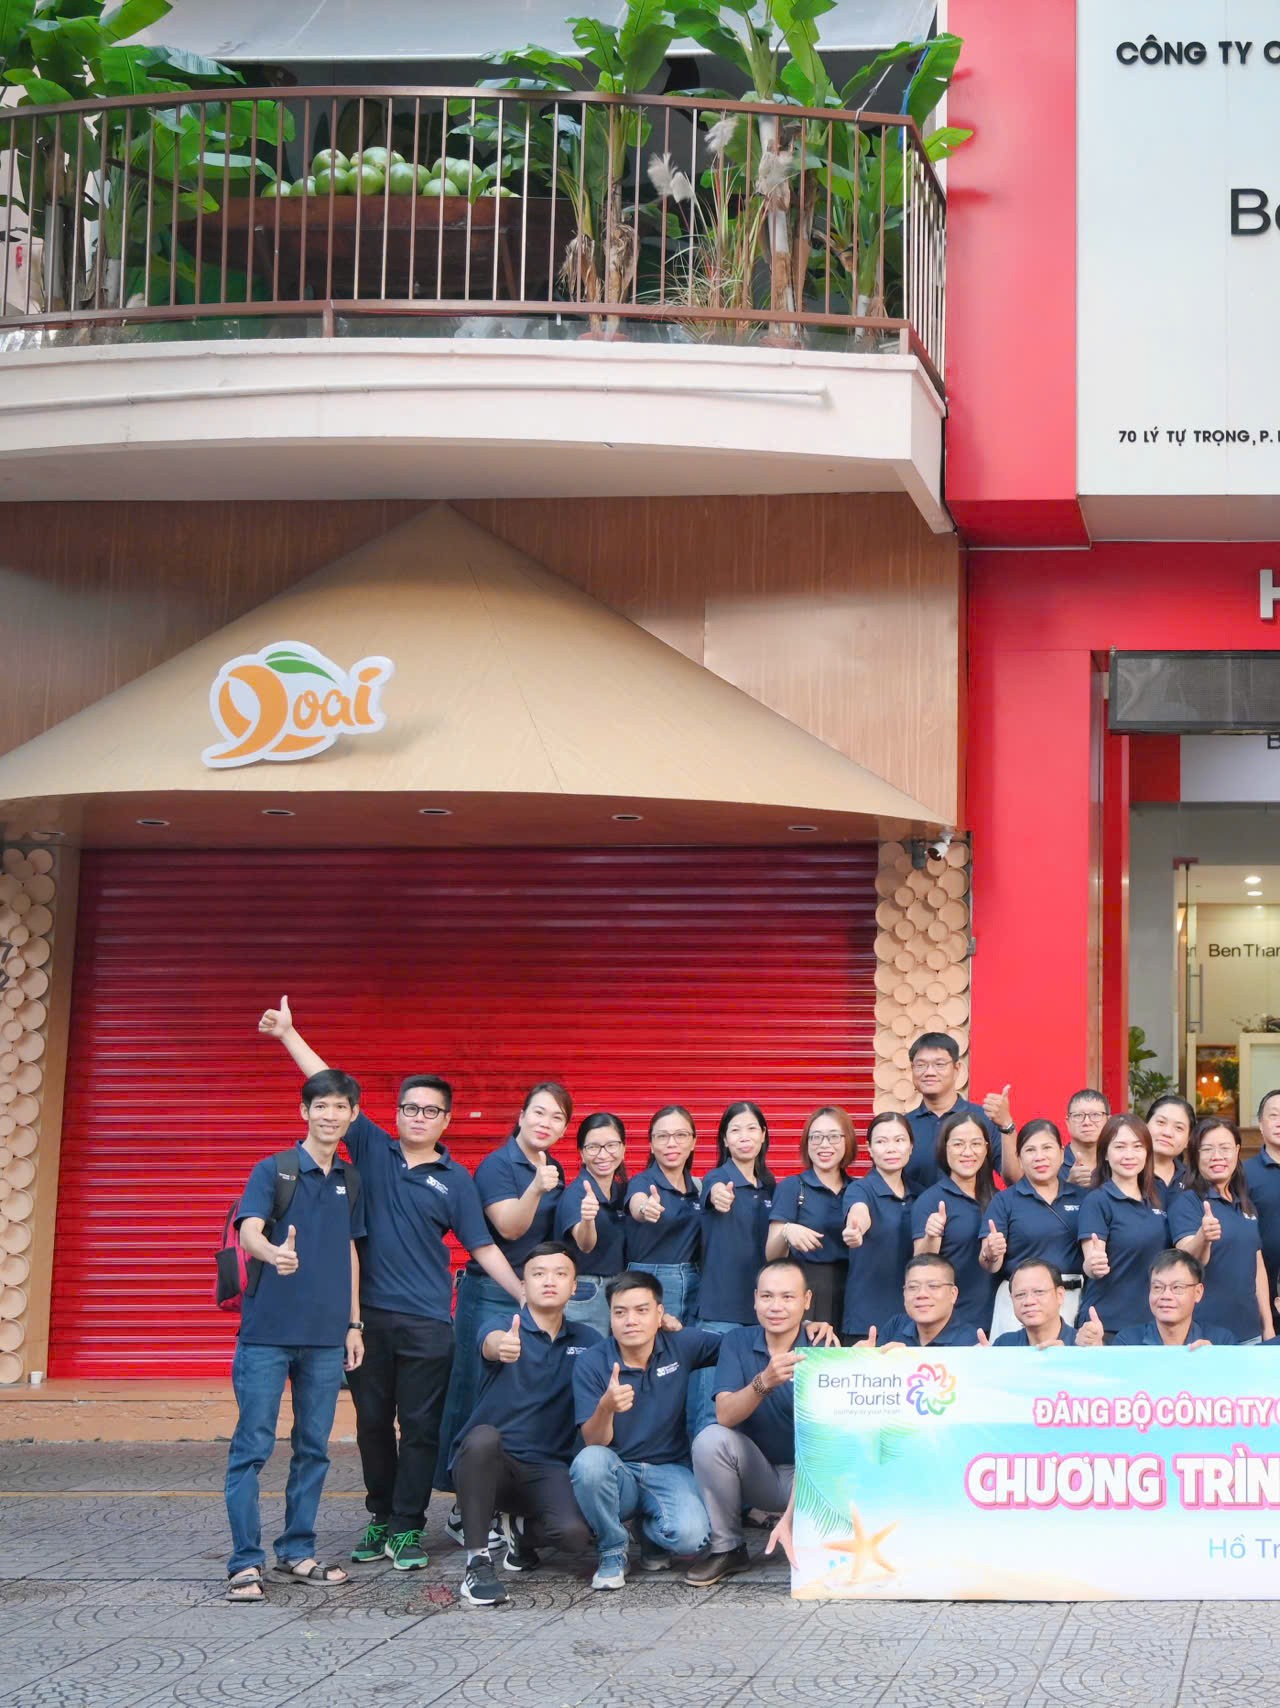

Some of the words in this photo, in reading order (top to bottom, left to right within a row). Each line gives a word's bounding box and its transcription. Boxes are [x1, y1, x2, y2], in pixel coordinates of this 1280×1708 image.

[1116, 34, 1207, 65] CÔNG
[1219, 40, 1253, 65] TY
[1118, 430, 1137, 443] 70
[1143, 425, 1159, 443] LÝ
[847, 1391, 901, 1406] Tourist
[1035, 1391, 1110, 1425] ĐẢNG
[1114, 1394, 1153, 1432] BỘ
[1156, 1393, 1234, 1425] CÔNG
[1237, 1399, 1273, 1425] TY
[966, 1454, 1164, 1508] CHƯƠNG
[1209, 1534, 1247, 1560] Hồ
